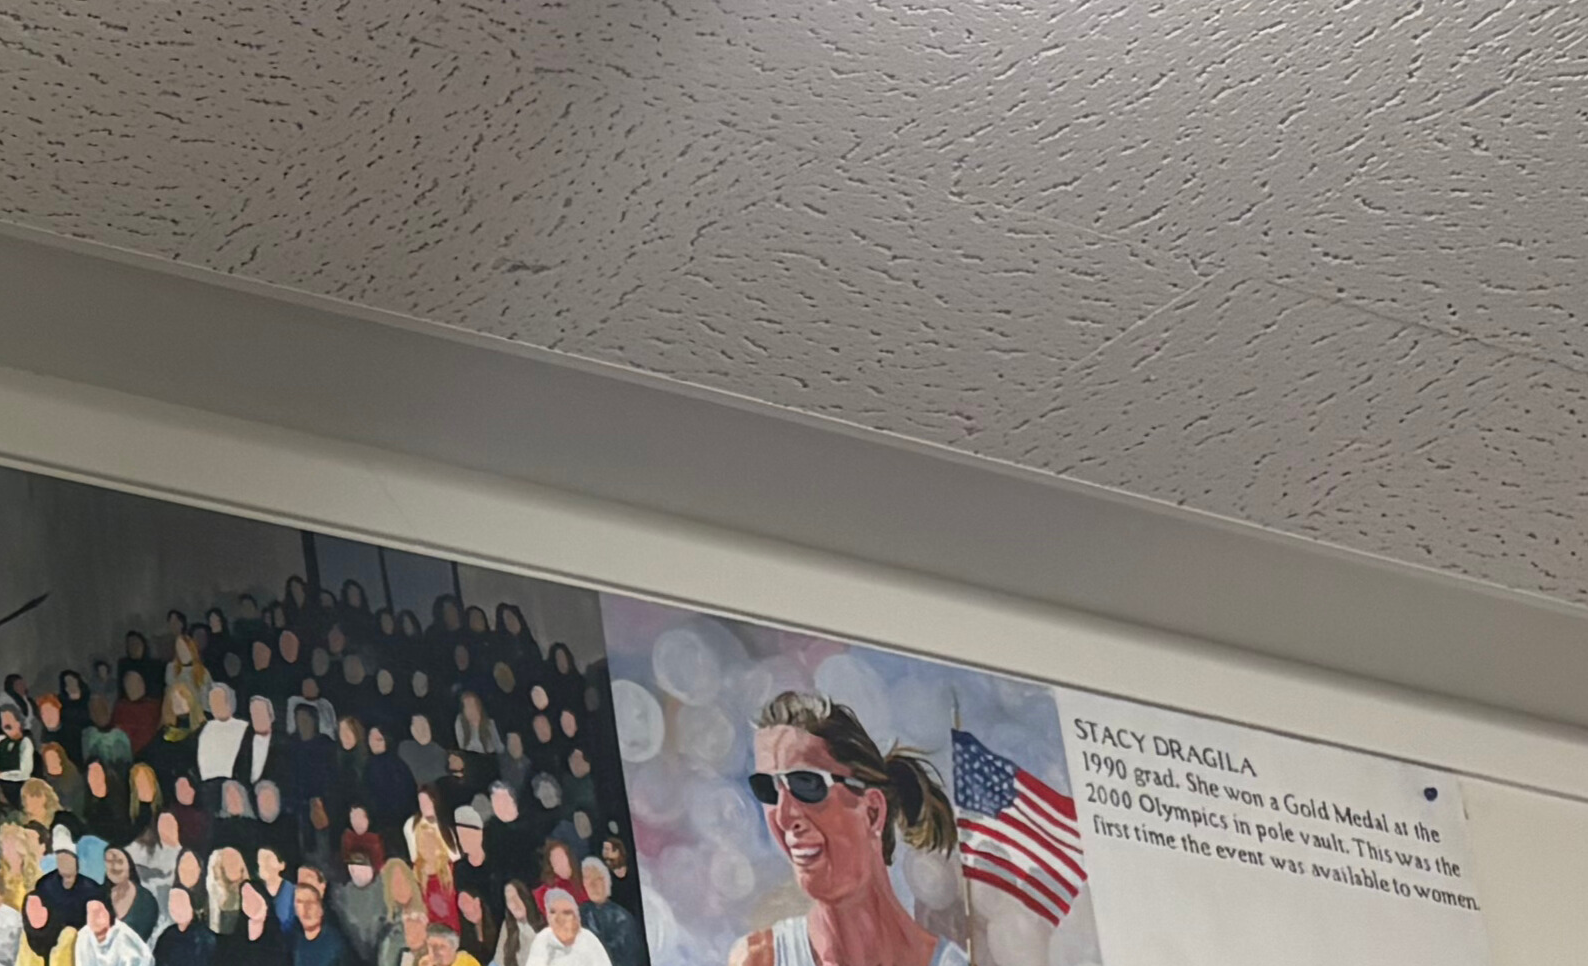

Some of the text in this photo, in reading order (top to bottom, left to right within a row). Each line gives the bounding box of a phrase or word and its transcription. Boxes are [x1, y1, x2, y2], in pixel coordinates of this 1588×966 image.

[1074, 718, 1257, 777] STACY DRAGILA
[1083, 751, 1441, 843] 1990 grad. She won a Gold Medal at the
[1085, 782, 1461, 877] 2000 Olympics in pole vault. This was the
[1093, 814, 1481, 911] first time the event was available to women.
